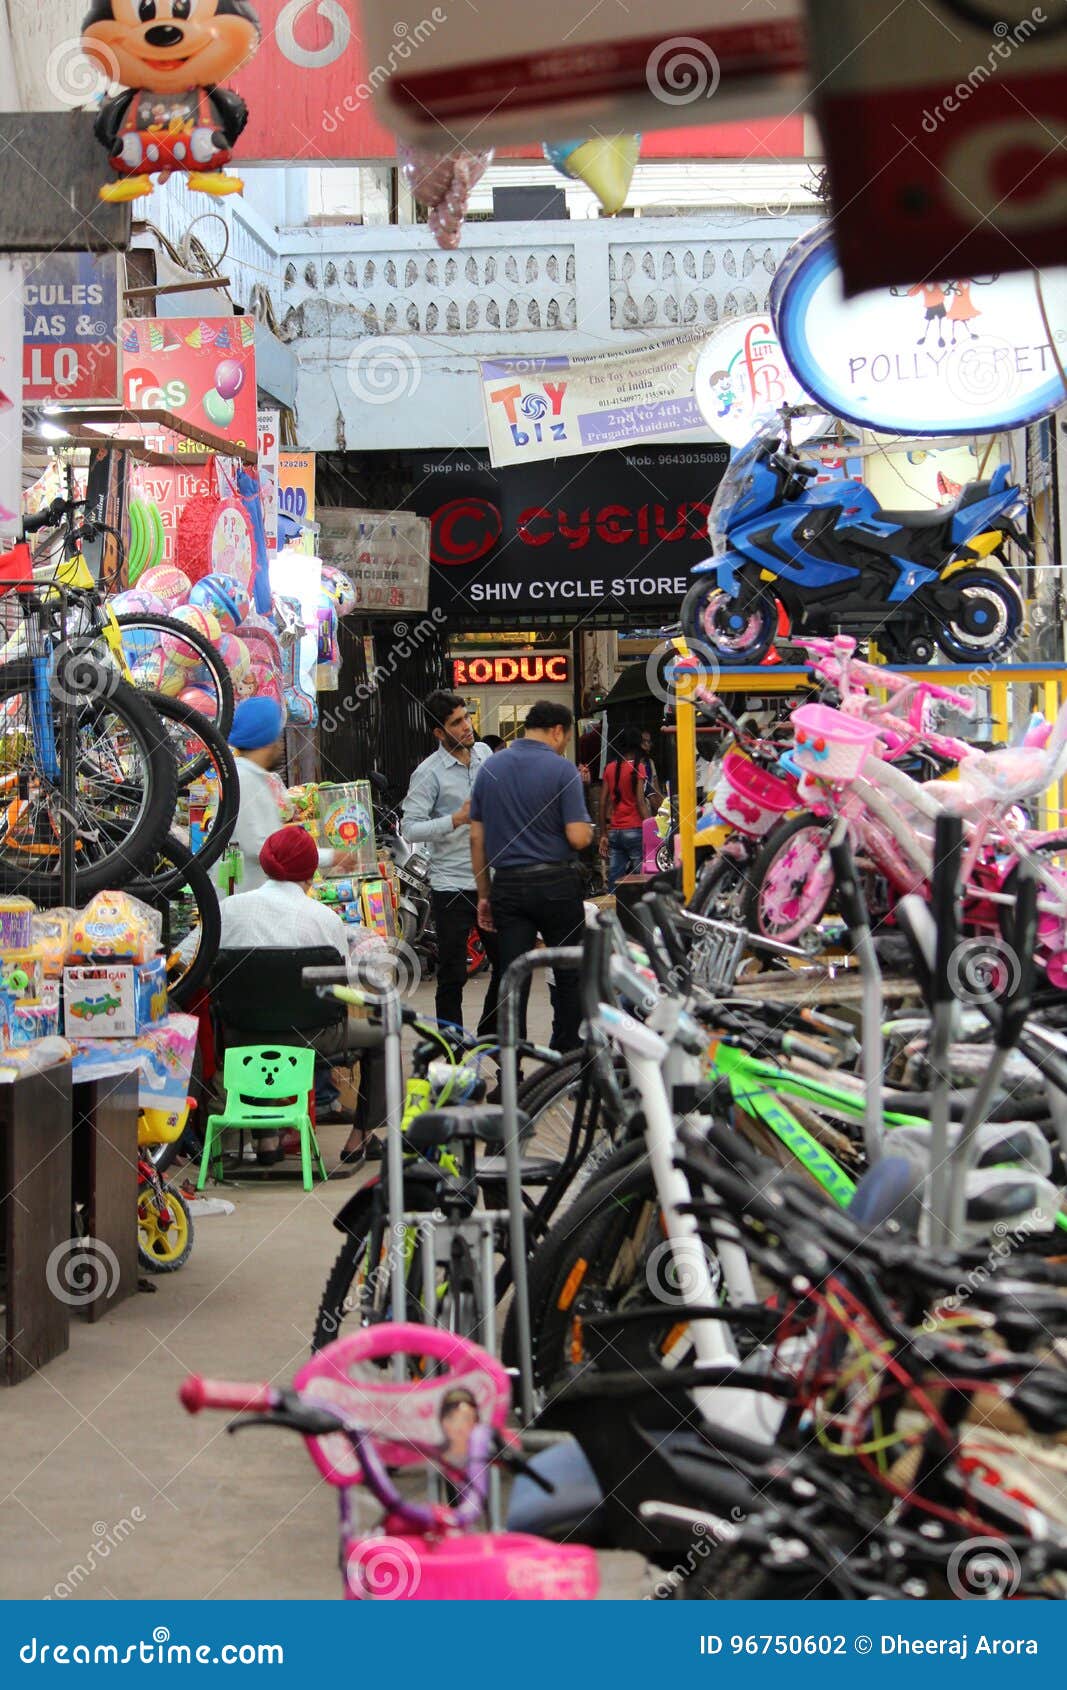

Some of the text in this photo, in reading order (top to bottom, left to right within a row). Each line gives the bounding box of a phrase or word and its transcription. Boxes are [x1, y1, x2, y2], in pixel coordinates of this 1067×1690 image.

[504, 359, 547, 374] 2017
[588, 374, 605, 385] The
[608, 371, 624, 383] Toy
[628, 362, 678, 379] Association
[616, 379, 654, 393] of India
[607, 410, 637, 426] 2nd
[639, 408, 653, 421] to
[657, 403, 681, 417] 4th
[586, 427, 630, 442] Pragati
[626, 452, 728, 466] Mob. 9643035089
[423, 463, 452, 474] Shop
[455, 462, 474, 472] No.
[470, 577, 688, 601] SHIV CYCLE STORE
